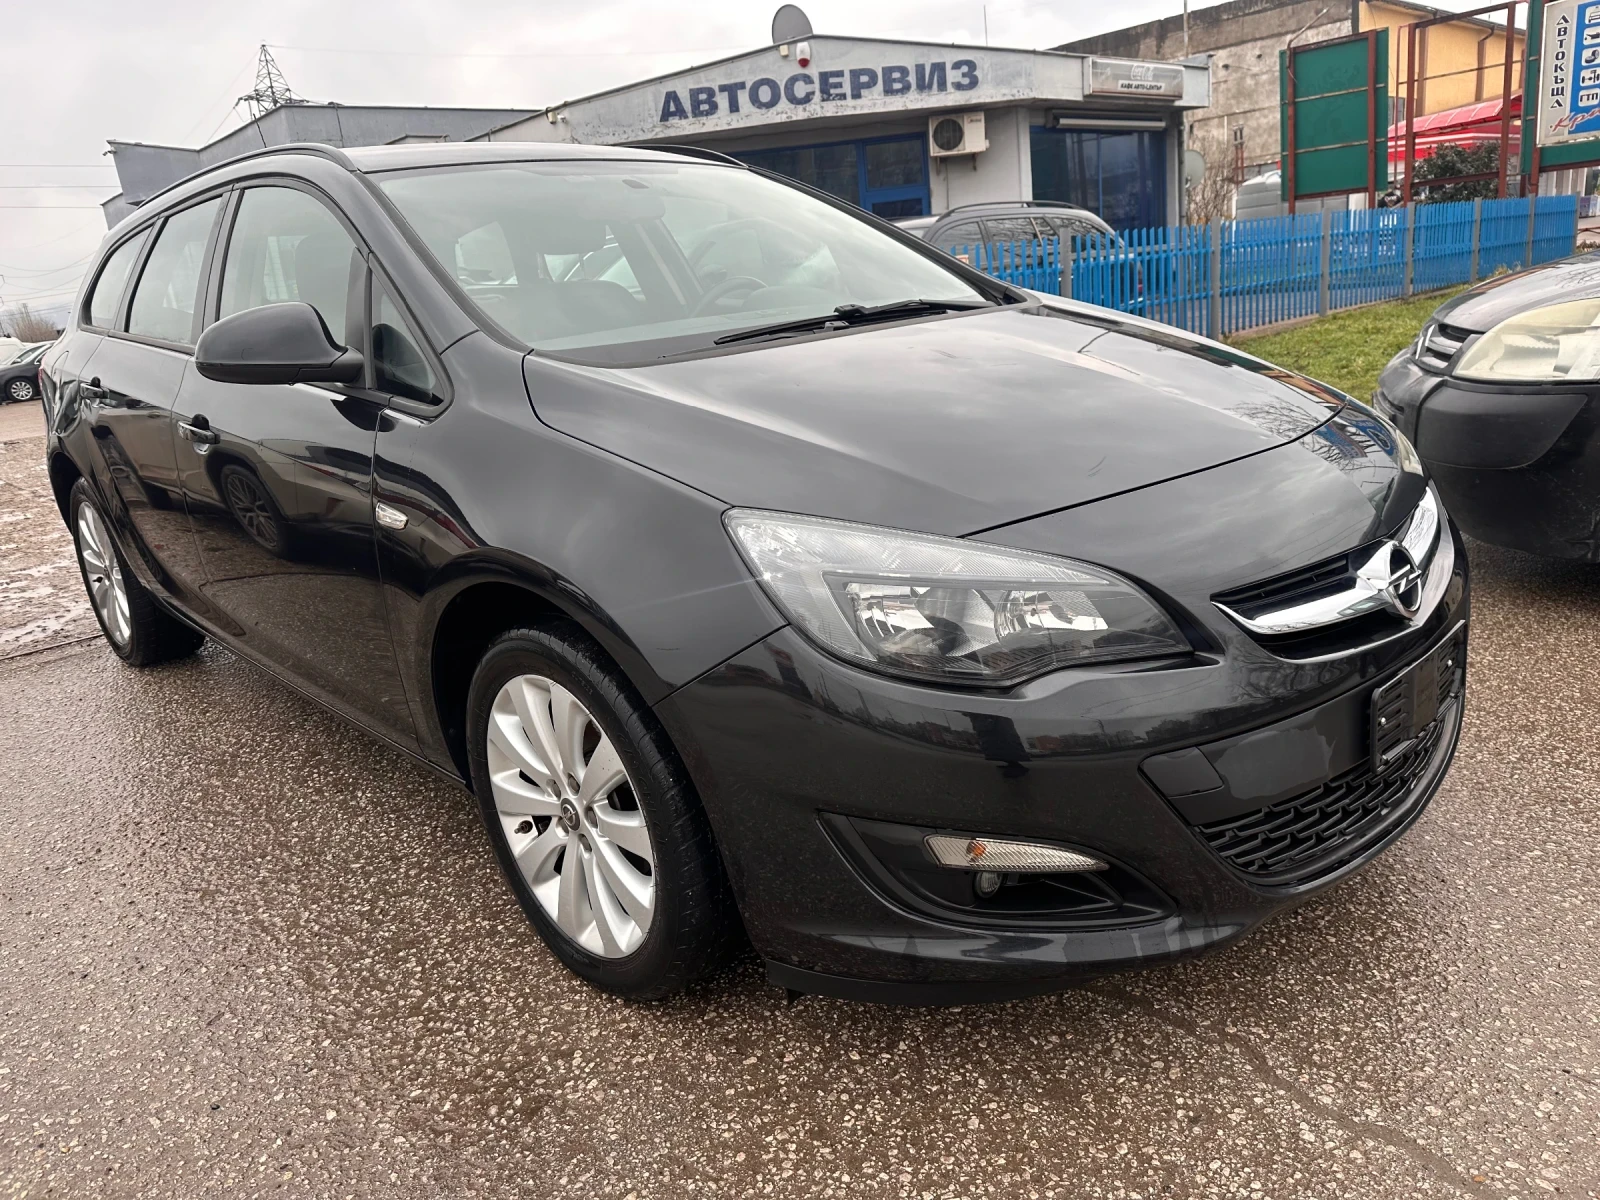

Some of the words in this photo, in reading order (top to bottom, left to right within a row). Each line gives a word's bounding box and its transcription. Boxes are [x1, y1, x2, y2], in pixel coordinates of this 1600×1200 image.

[659, 59, 980, 123] АВТОСЕРВИЗ
[1550, 15, 1570, 109] АВТОКЪЩА
[1580, 92, 1598, 102] ГТП
